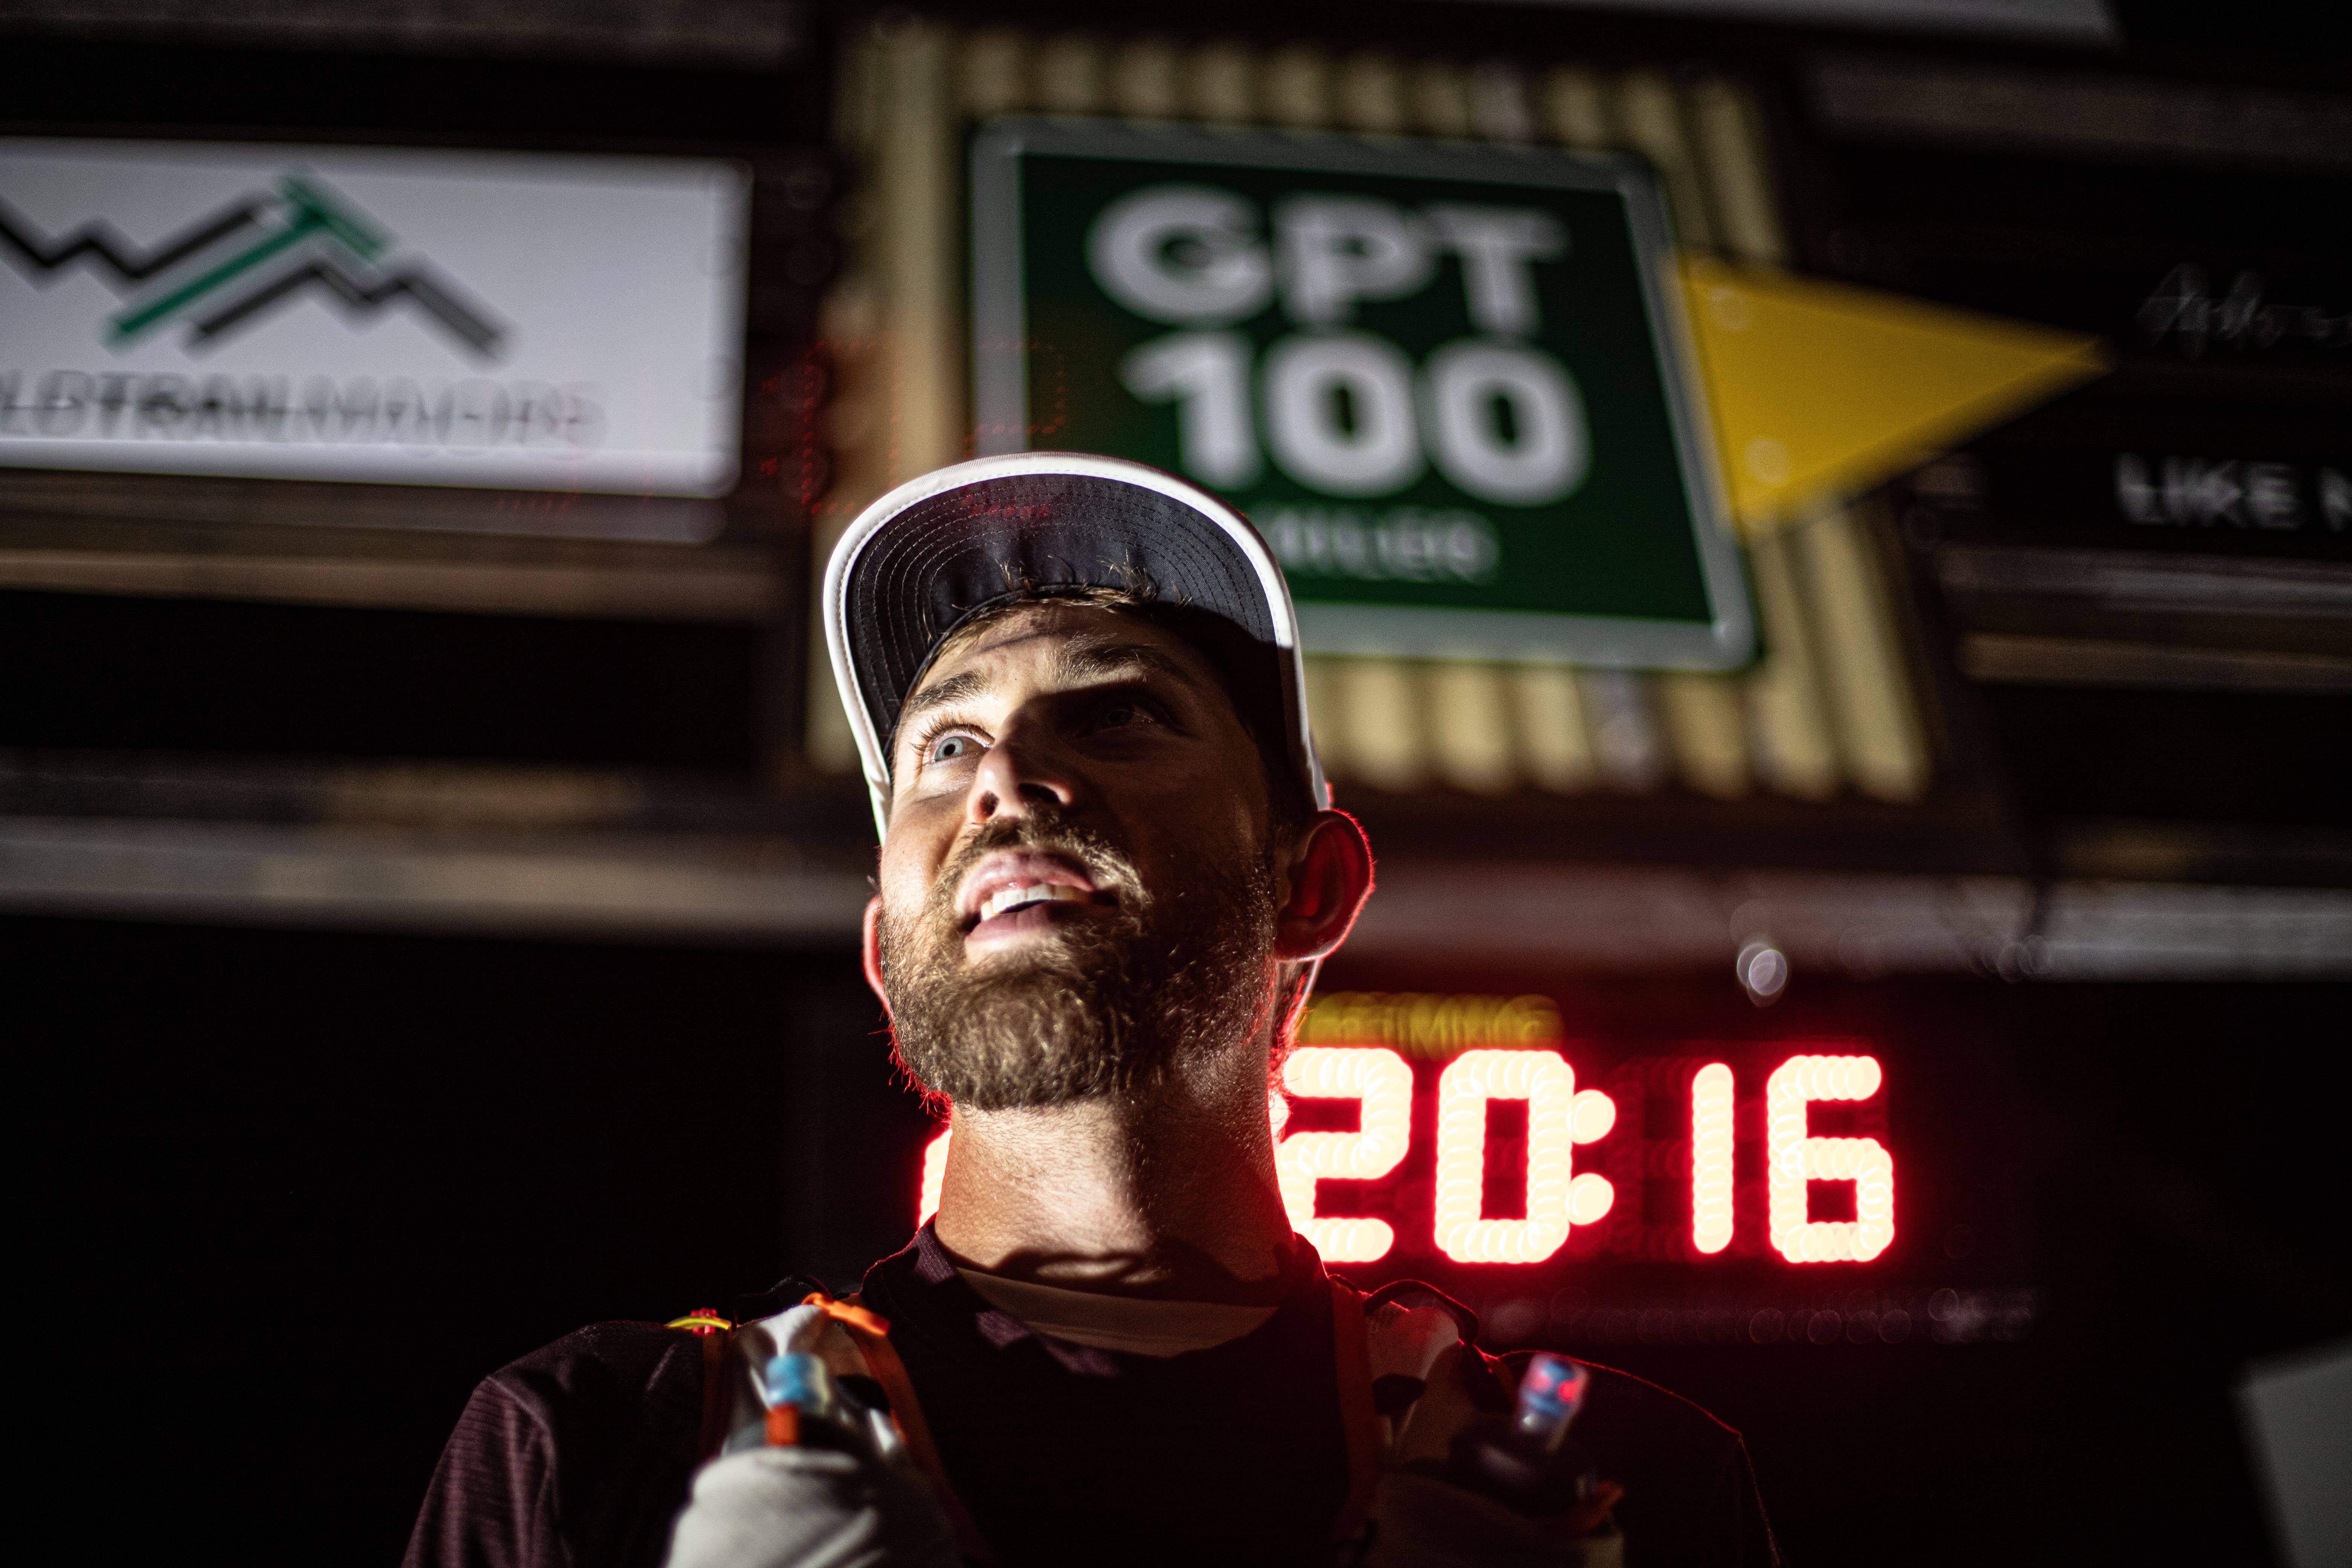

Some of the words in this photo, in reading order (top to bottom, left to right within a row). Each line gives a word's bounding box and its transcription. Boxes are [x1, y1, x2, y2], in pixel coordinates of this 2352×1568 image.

[1087, 188, 1566, 332] GPT
[1125, 331, 1589, 504] 100
[2115, 454, 2303, 531] LIKE
